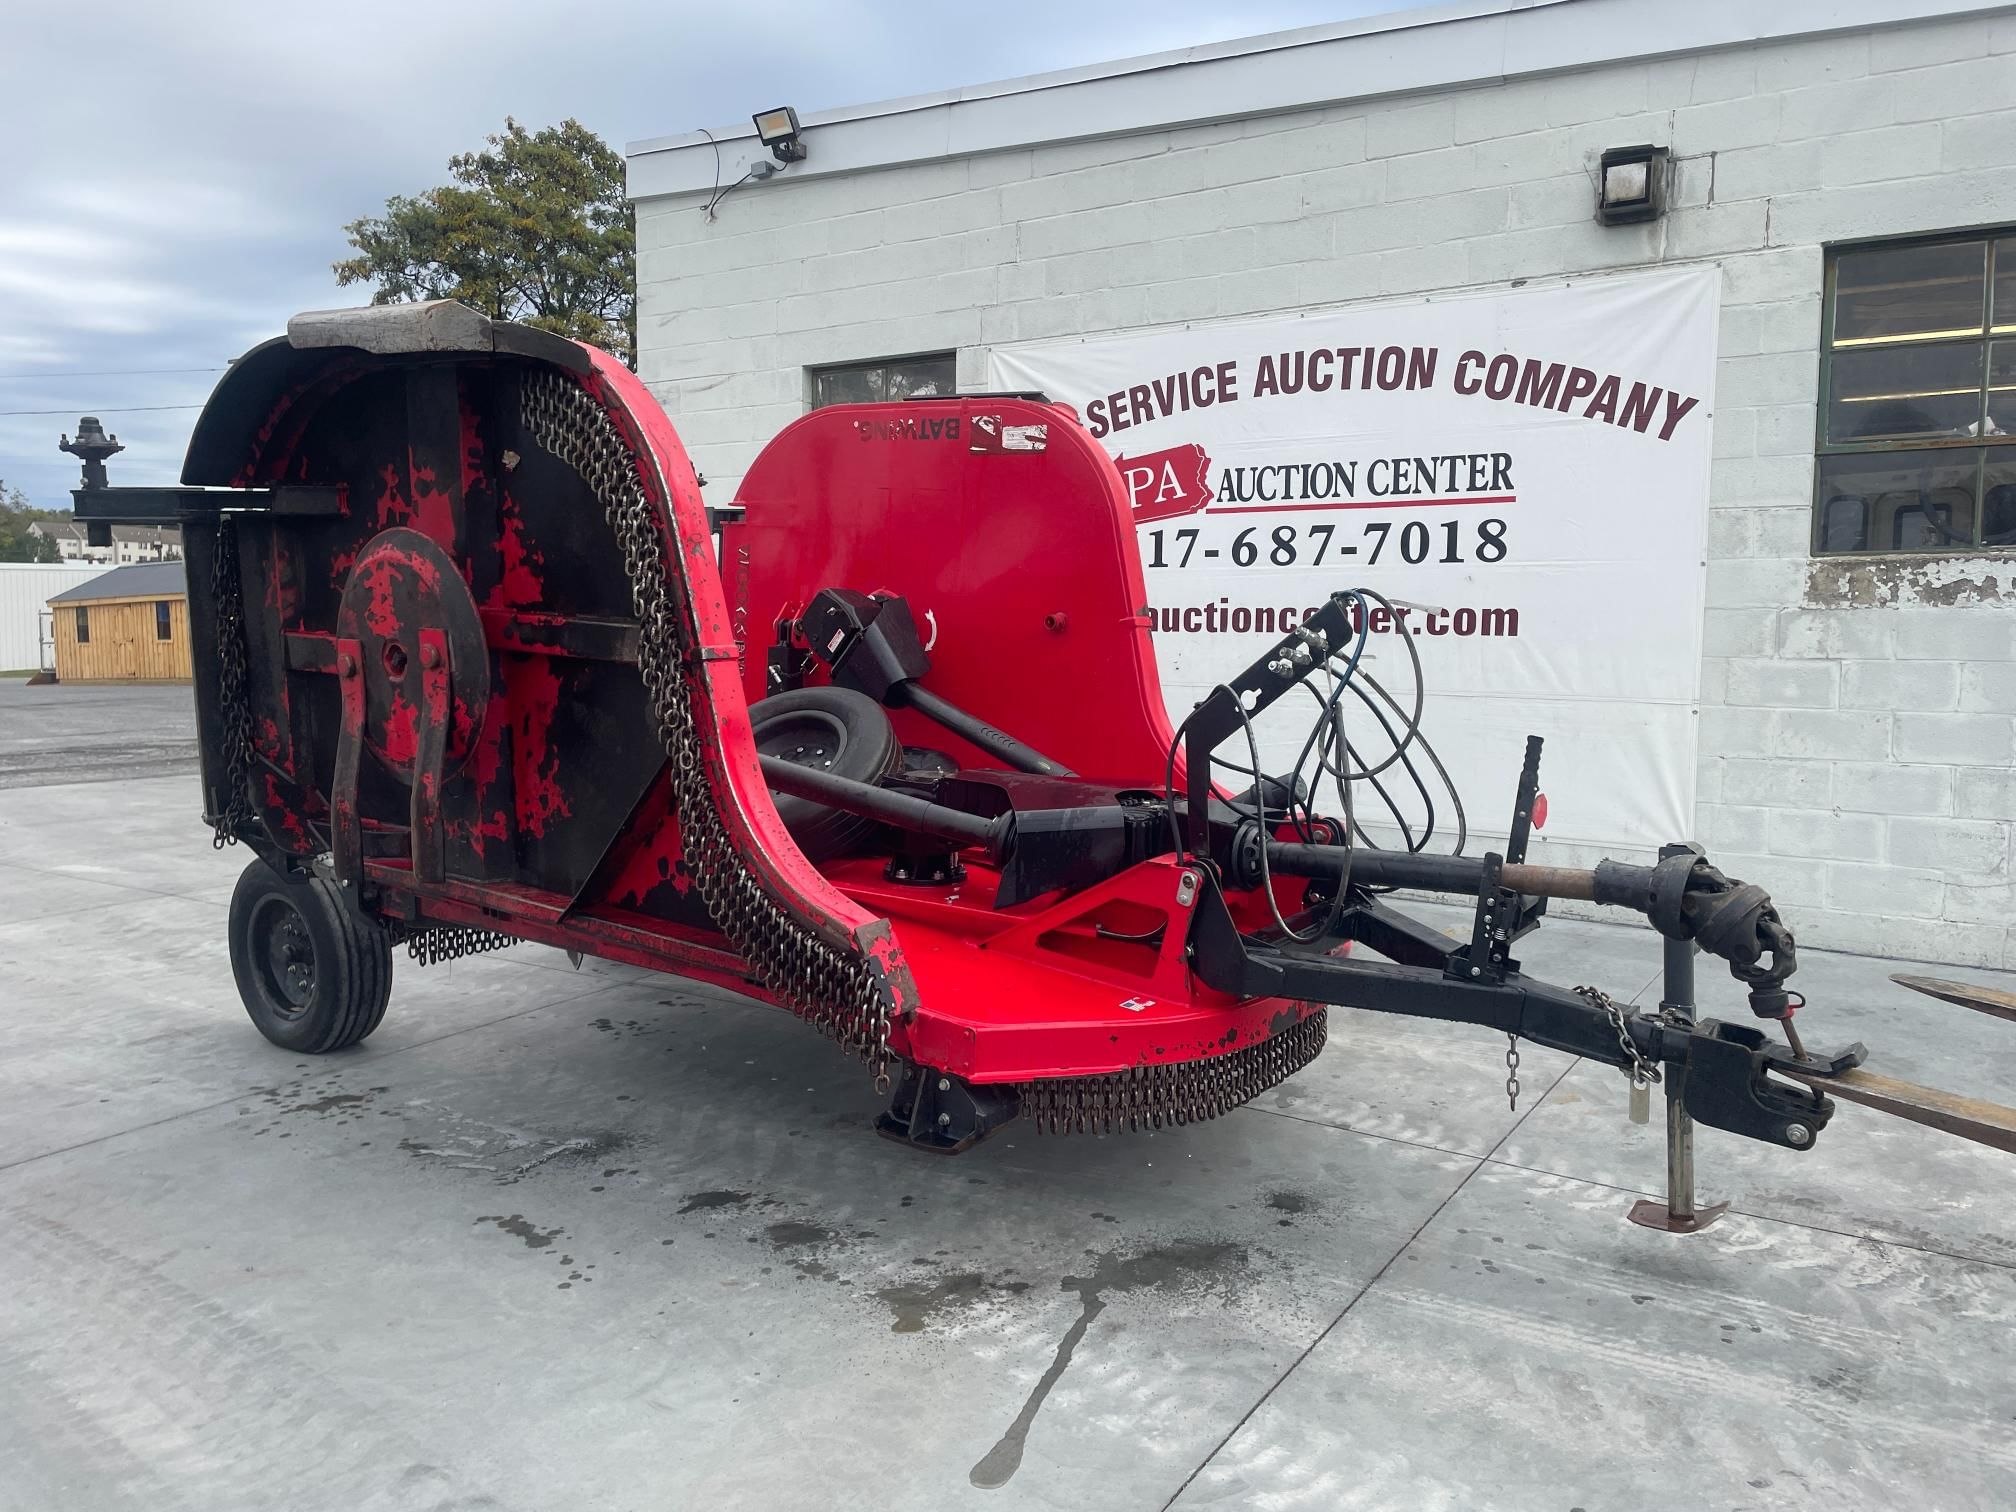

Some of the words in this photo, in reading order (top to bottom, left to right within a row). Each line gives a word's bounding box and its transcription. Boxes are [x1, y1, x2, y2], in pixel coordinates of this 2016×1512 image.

[1086, 360, 1239, 439] SERVICE
[1253, 345, 1439, 398] AUCTION
[1453, 350, 1700, 442] COMPANY
[1123, 459, 1188, 509] PA
[1216, 461, 1358, 503] AUCTION
[1366, 452, 1515, 497] CENTER
[1136, 518, 1508, 568] 17-687-7018
